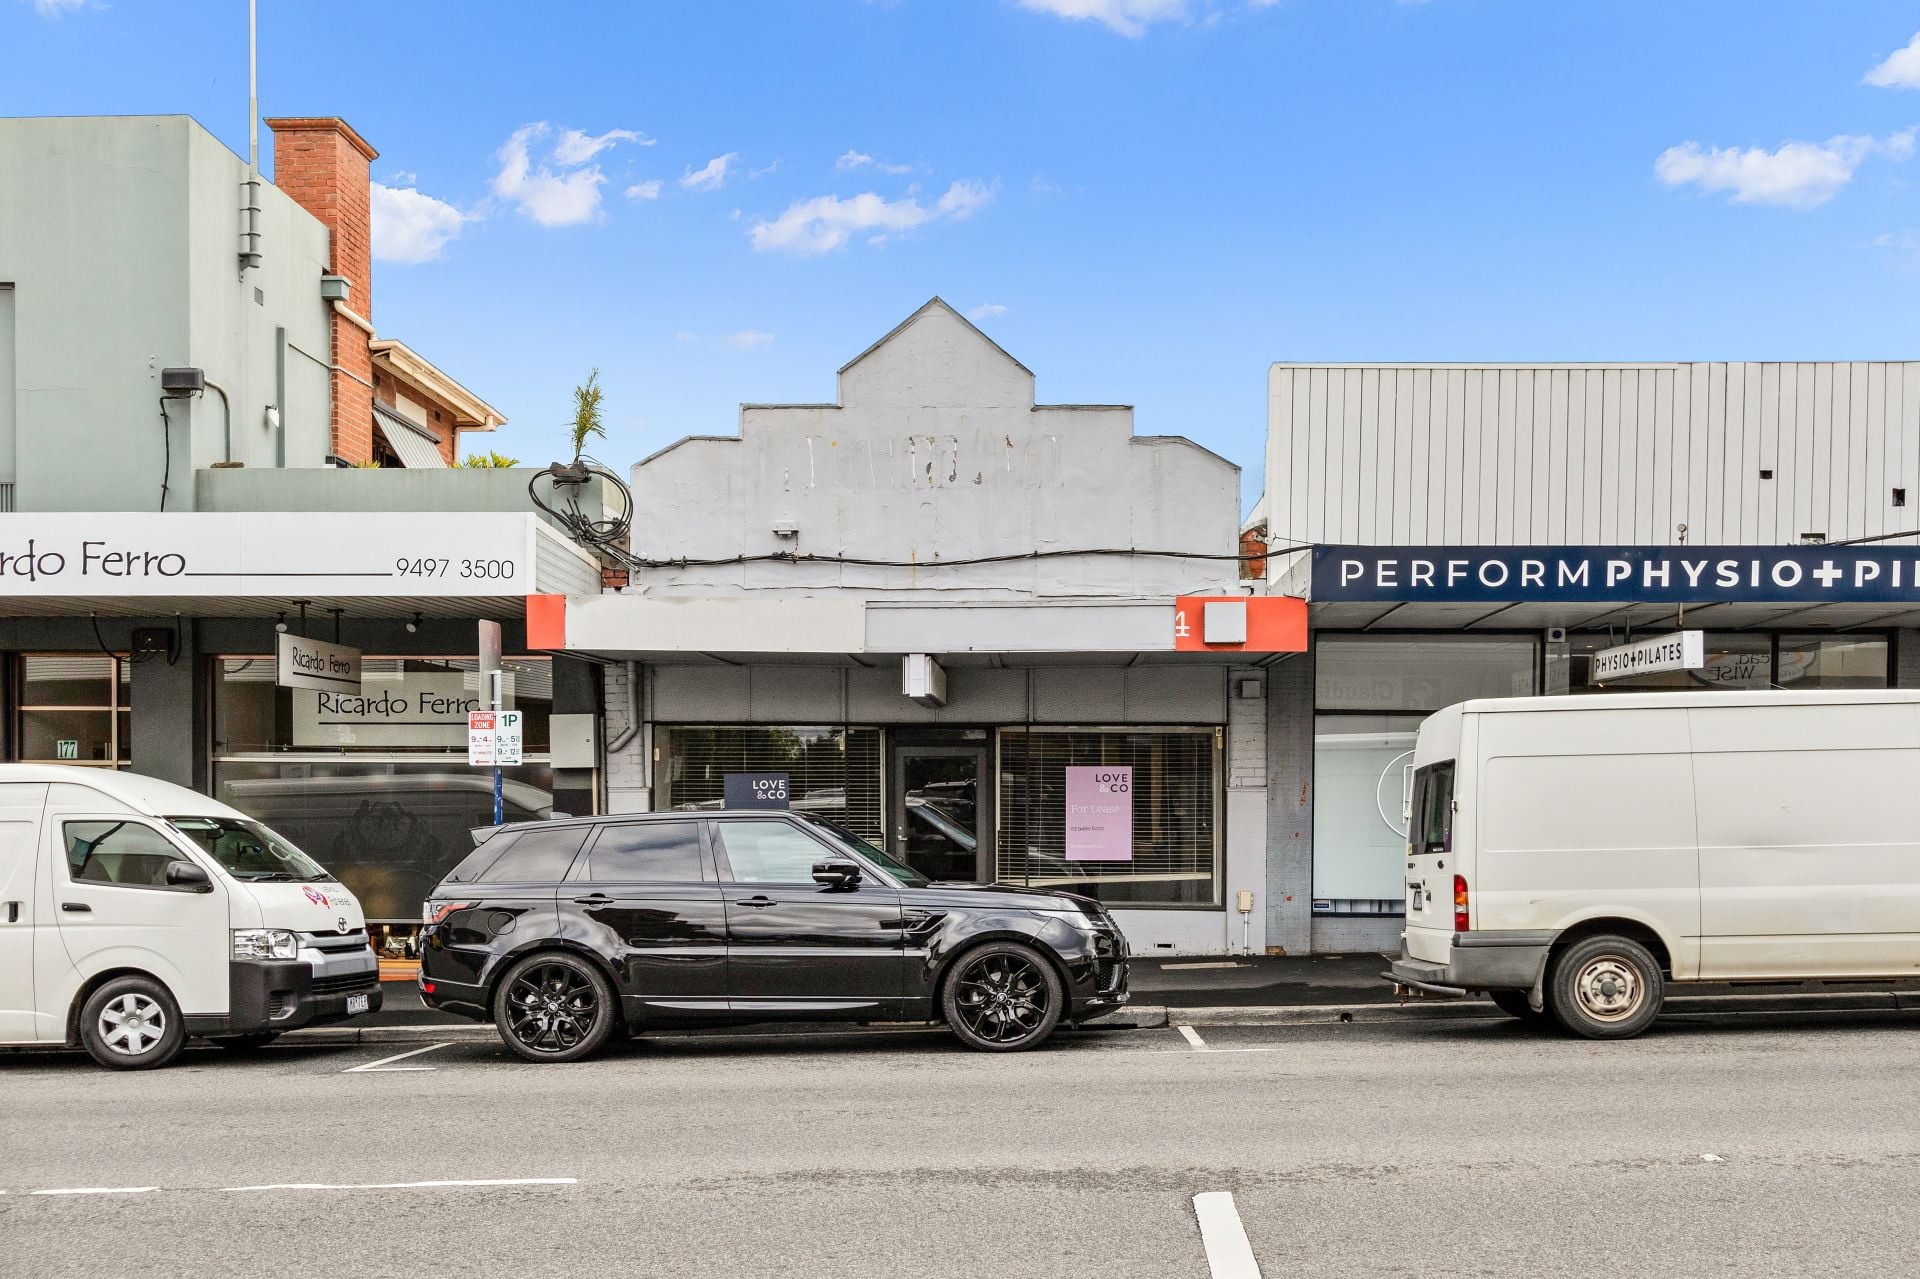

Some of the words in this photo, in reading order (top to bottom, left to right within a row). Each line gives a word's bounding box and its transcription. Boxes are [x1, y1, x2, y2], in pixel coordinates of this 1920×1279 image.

[82, 541, 186, 576] Ferro
[396, 558, 450, 577] 9497
[460, 559, 514, 579] 3500
[1341, 560, 1588, 587] PERFORM
[292, 646, 325, 672] Ricardo
[329, 654, 351, 675] Ferro
[318, 690, 408, 717] Ricardo
[419, 692, 480, 714] Ferro
[471, 713, 494, 721] LOADING
[500, 714, 518, 727] 1P
[474, 721, 491, 729] ZONE
[59, 742, 76, 758] 177
[752, 780, 785, 789] LOVE
[1095, 773, 1128, 783] LOVE
[1071, 804, 1089, 813] For
[1090, 804, 1120, 813] Lease
